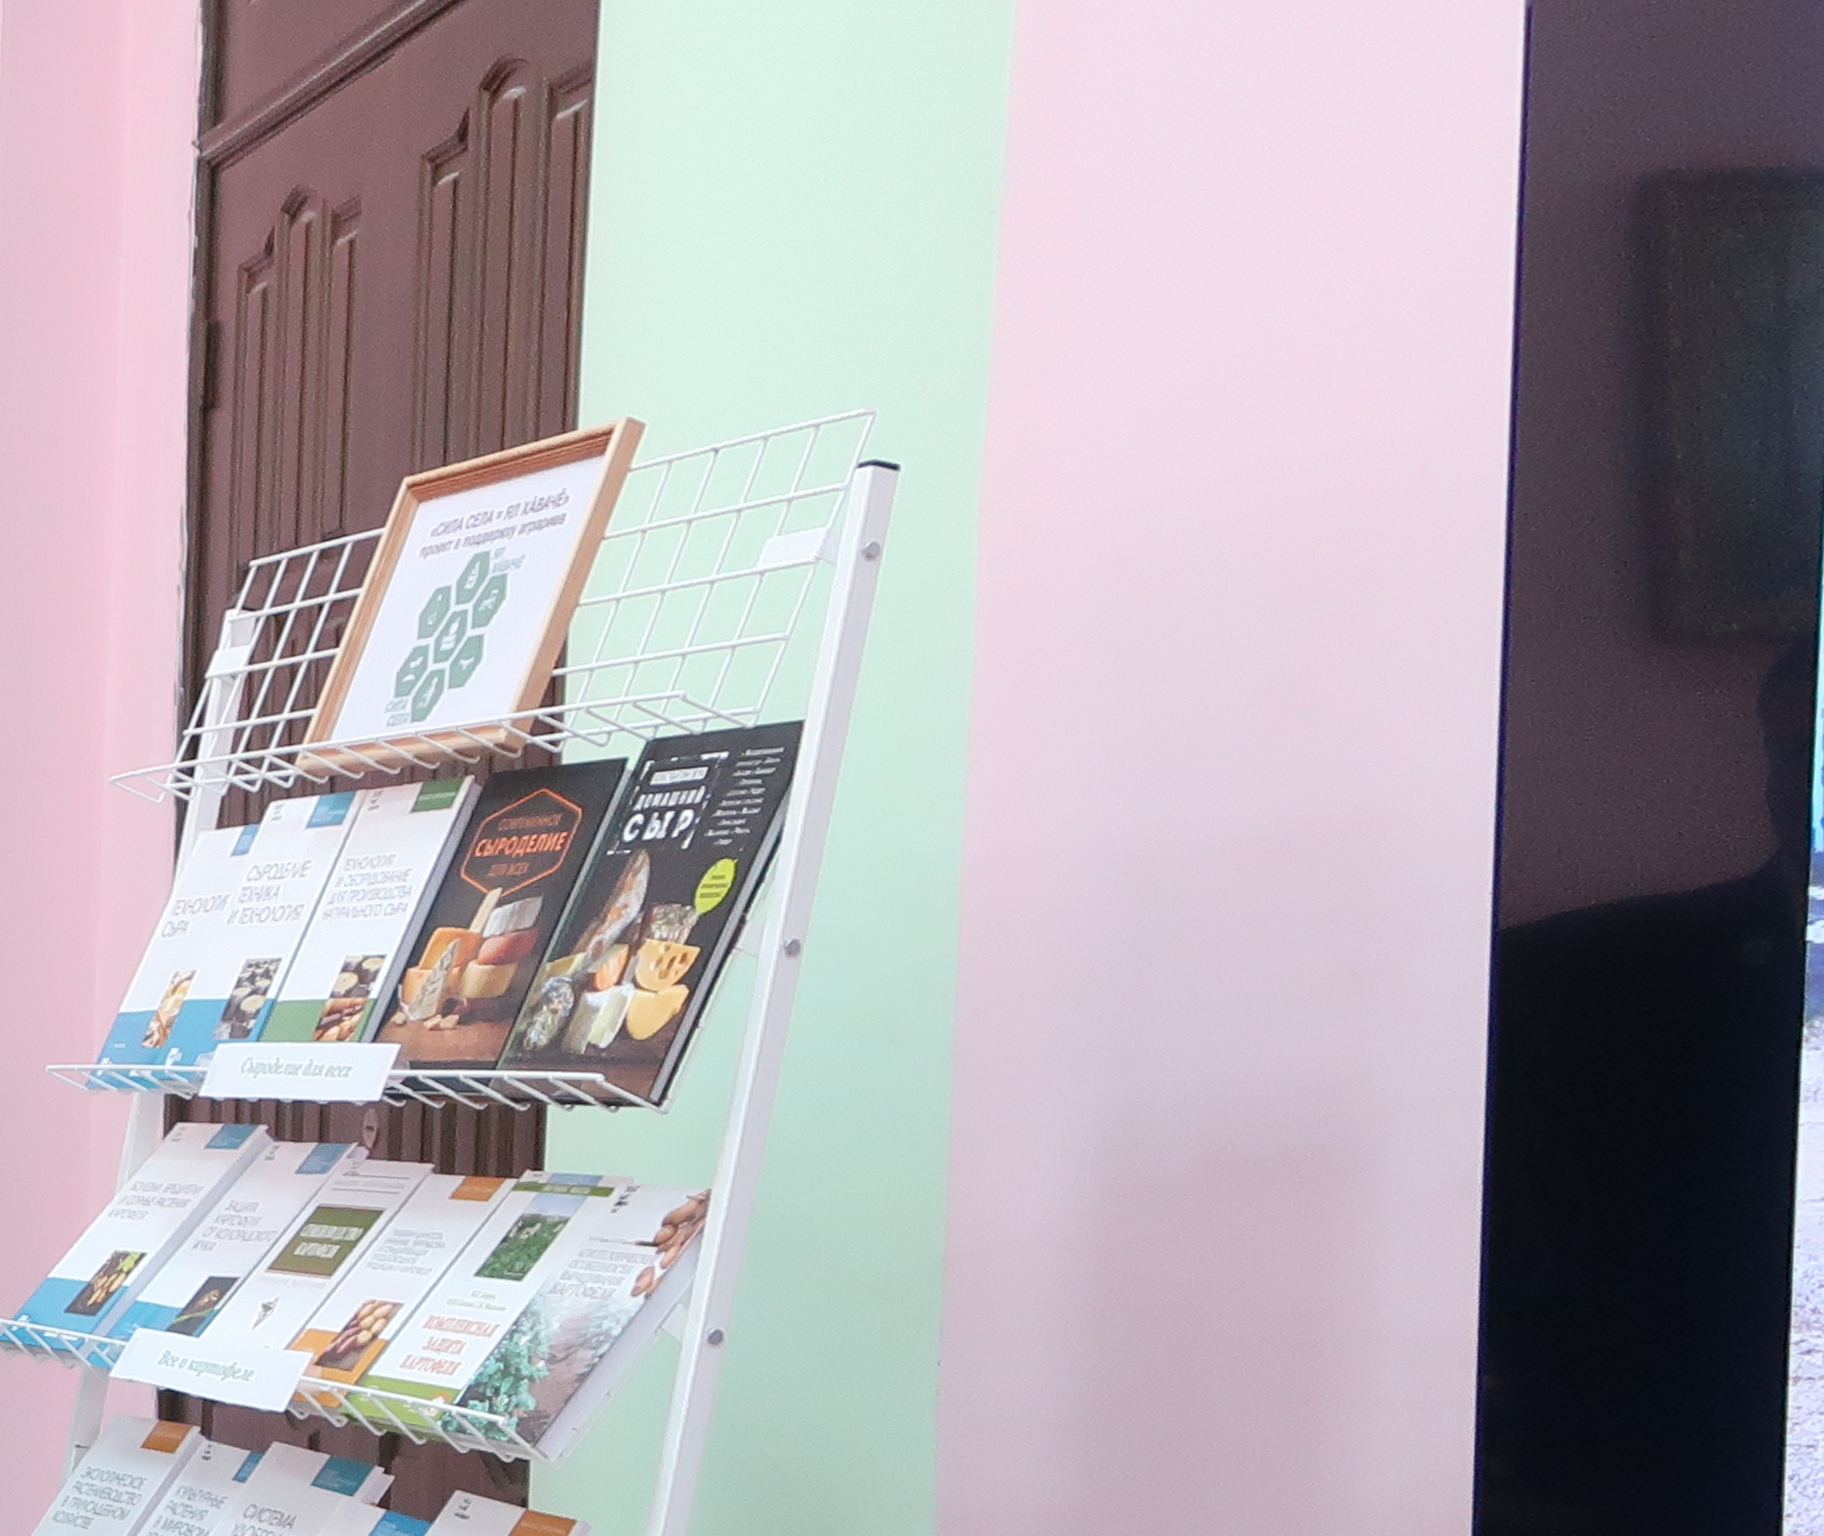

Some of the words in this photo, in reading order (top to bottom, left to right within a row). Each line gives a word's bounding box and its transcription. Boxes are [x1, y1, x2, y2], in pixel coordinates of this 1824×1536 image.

[633, 784, 707, 812] ДОМАШНИЙ
[622, 809, 695, 843] СЫР
[474, 831, 571, 857] СЫРОДЕЛИЕ
[242, 1502, 298, 1530] СИСТЕМА
